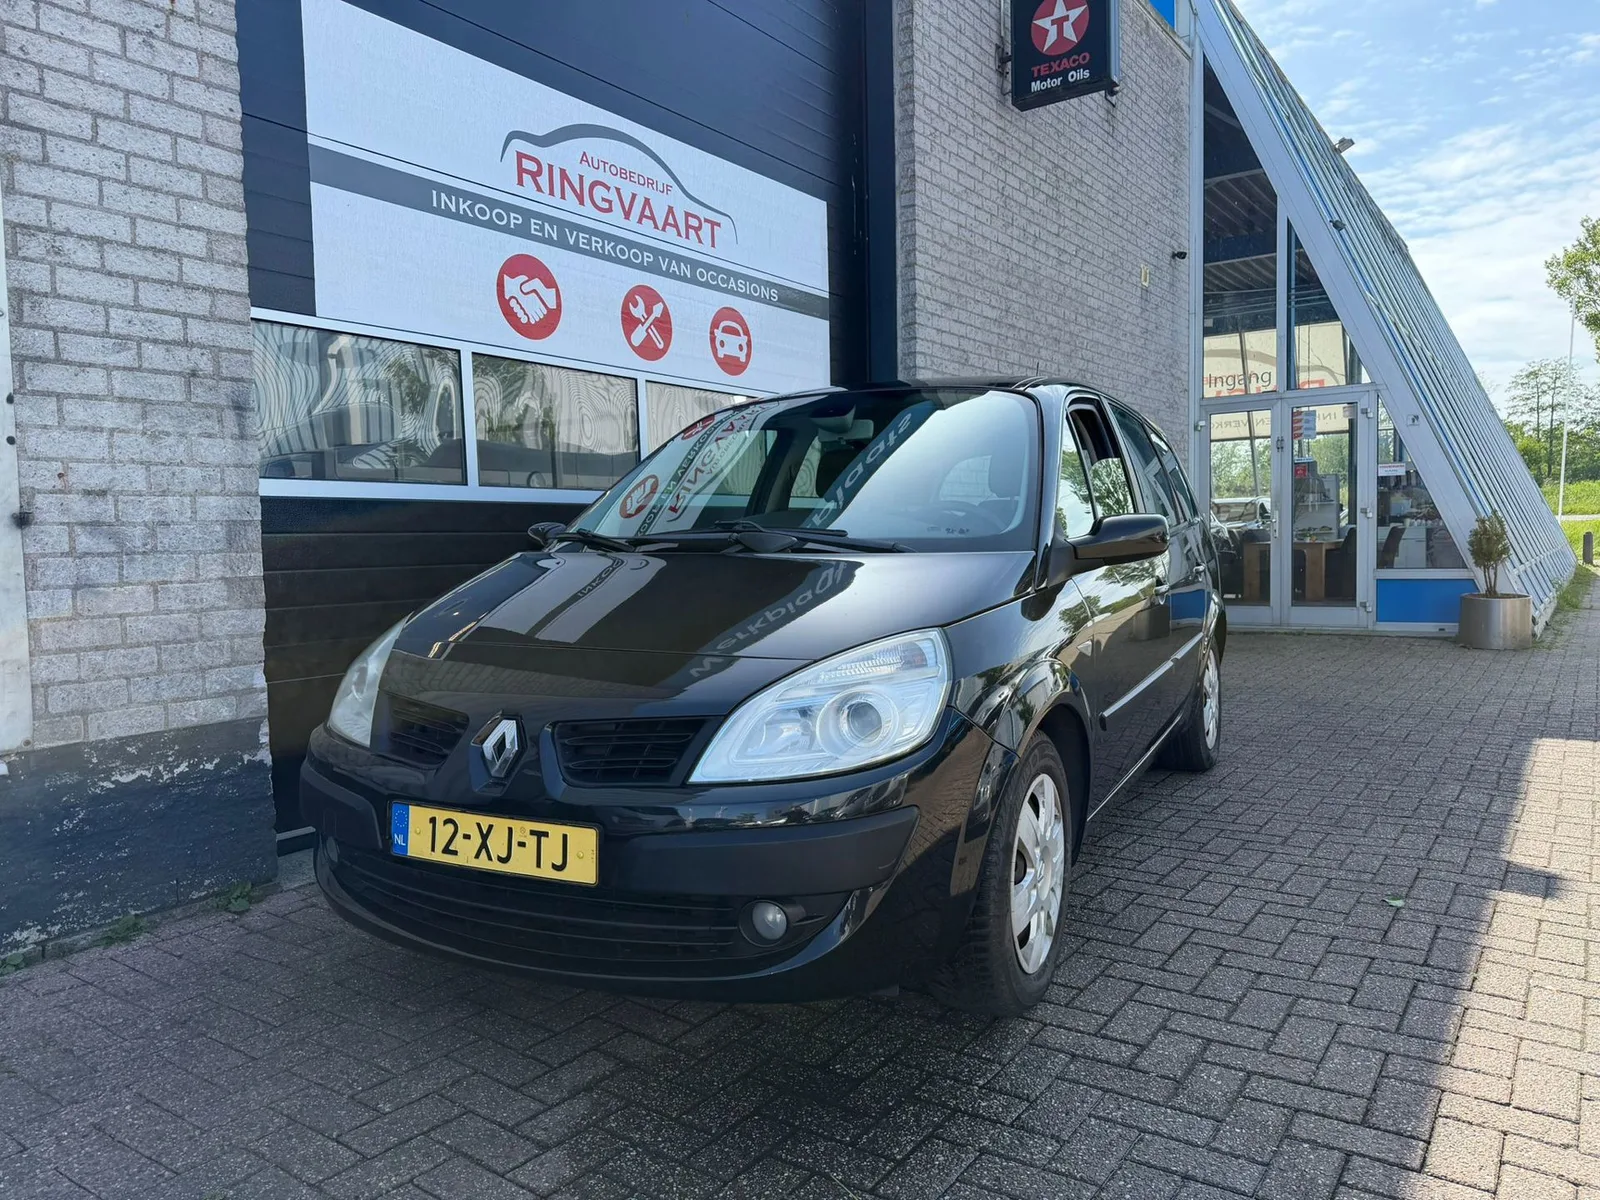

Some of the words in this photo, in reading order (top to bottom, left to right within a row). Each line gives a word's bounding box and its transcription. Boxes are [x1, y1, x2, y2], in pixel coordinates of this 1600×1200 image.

[1031, 52, 1090, 78] TEXACO
[1031, 76, 1062, 93] Motor
[1068, 68, 1090, 83] Oils
[579, 151, 673, 195] AUTOBEDRIJF
[515, 150, 721, 248] RINGVAART
[432, 189, 523, 229] INKOOP
[530, 219, 558, 240] EN
[565, 230, 654, 266] VERKOOP
[659, 256, 691, 278] VAN
[696, 267, 779, 301] OCCASIONS
[1208, 371, 1272, 391] Ingang
[394, 833, 406, 847] NL
[428, 815, 569, 872] 12-XJ-TJ
